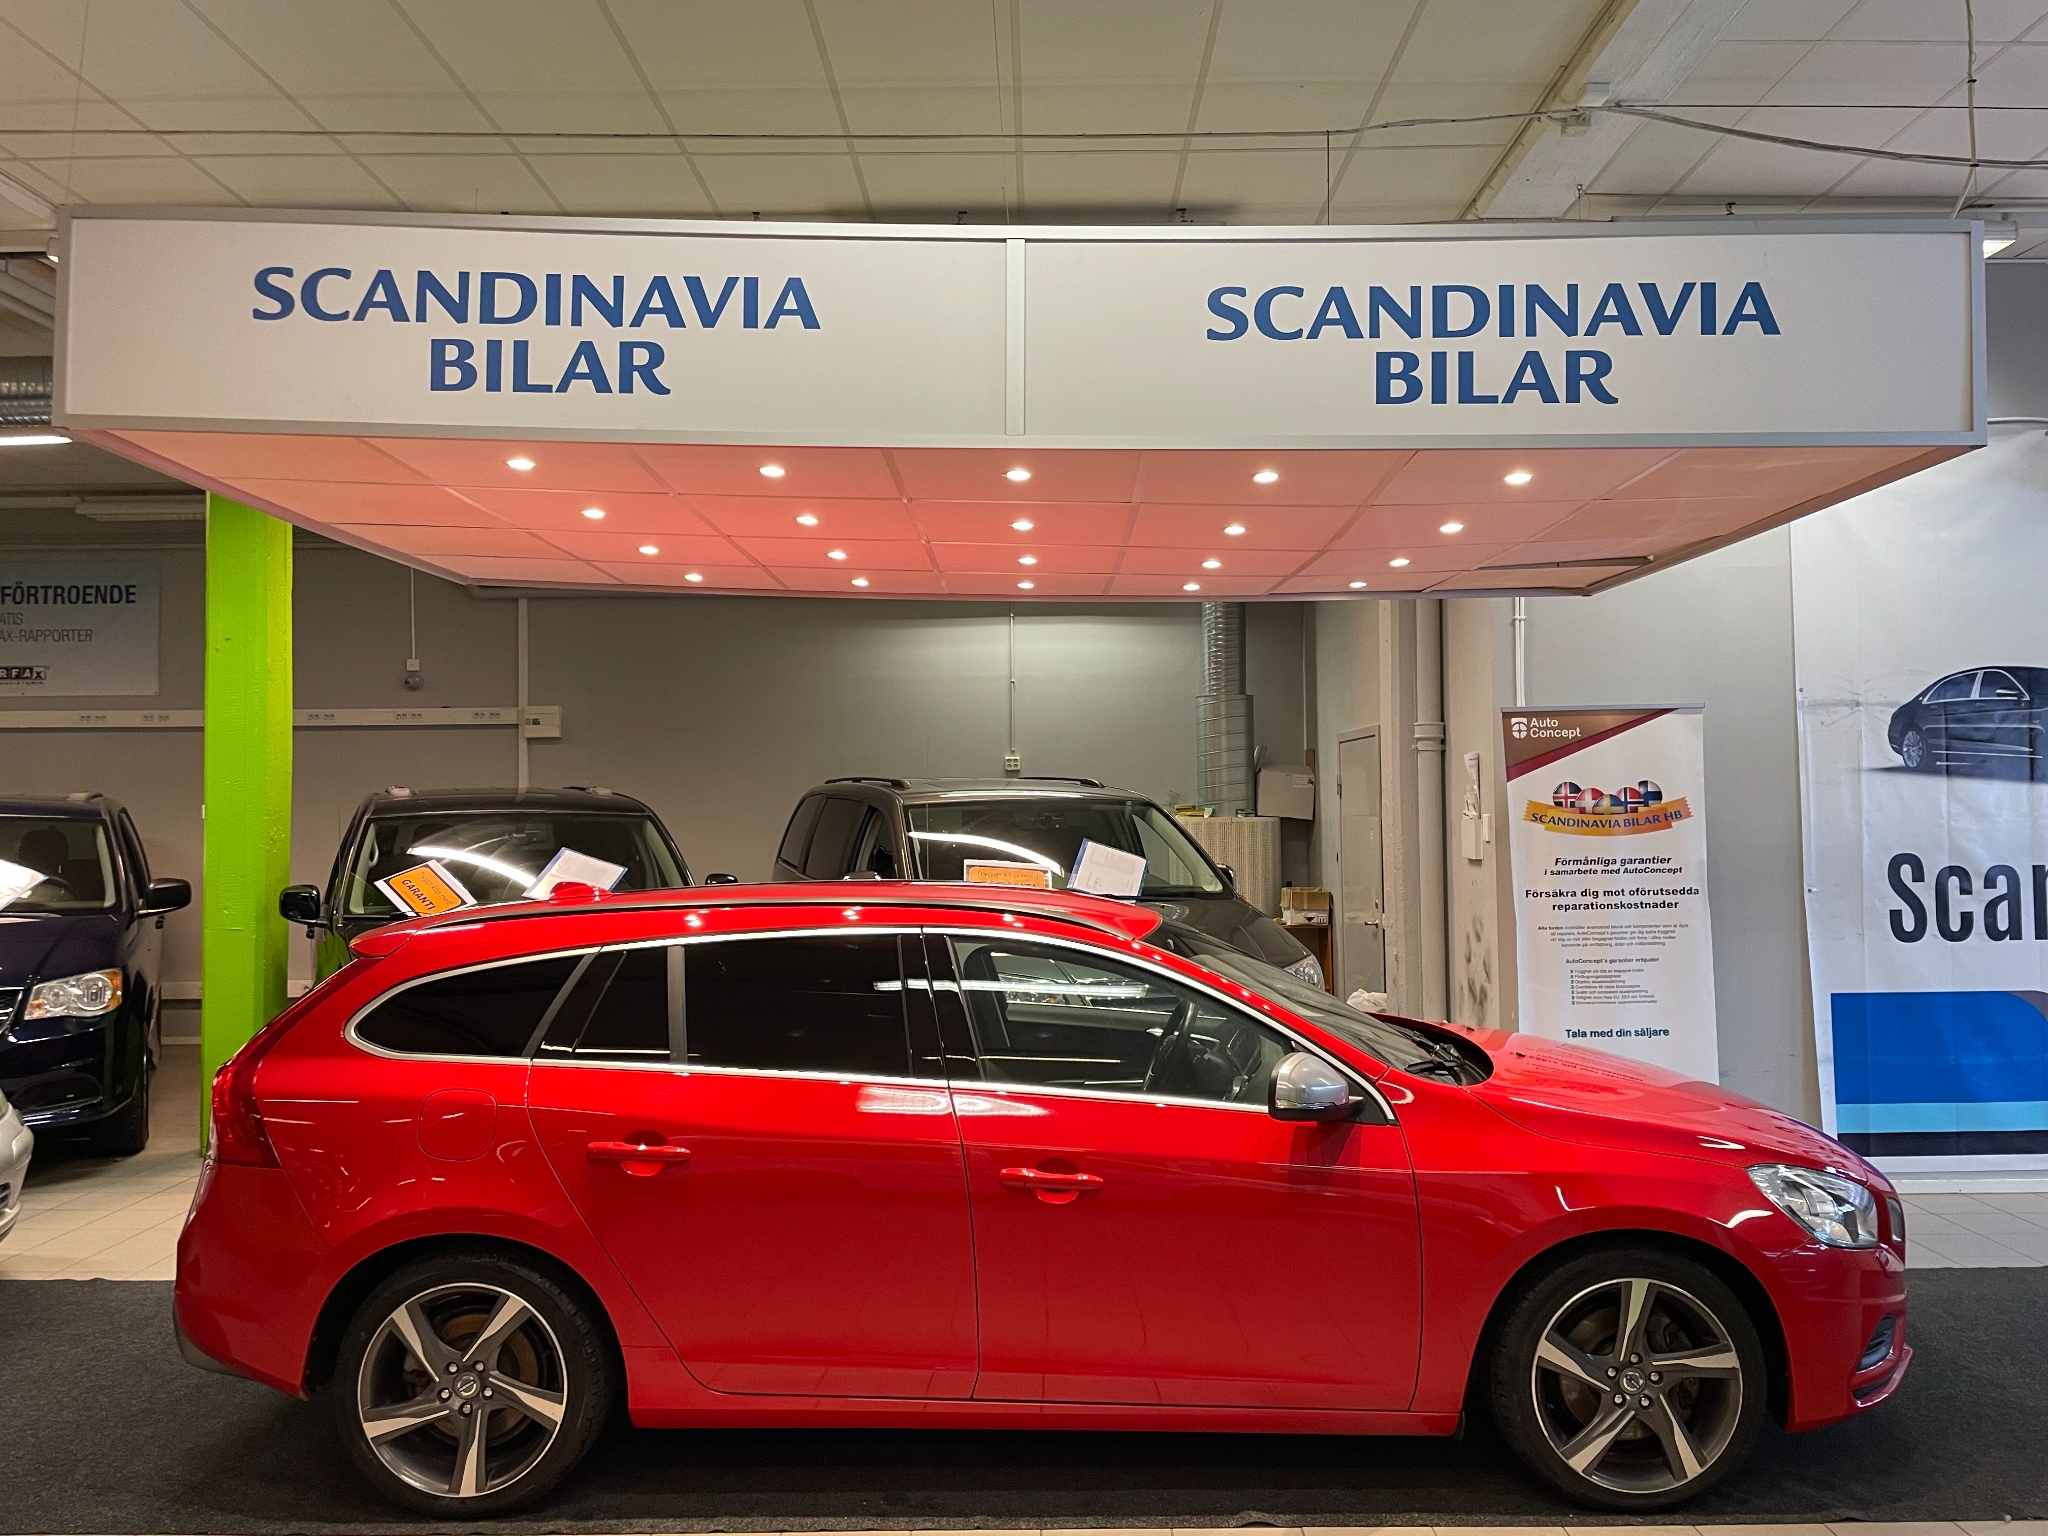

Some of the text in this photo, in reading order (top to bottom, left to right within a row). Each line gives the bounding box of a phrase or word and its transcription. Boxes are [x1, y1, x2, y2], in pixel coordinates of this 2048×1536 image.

[252, 266, 821, 330] SCANDINAVIA
[1206, 282, 1781, 341] SCANDINAVIA
[430, 338, 671, 395] BILAR
[1375, 349, 1619, 405] BILAR
[1, 582, 136, 605] FÖRTROENDE
[1530, 717, 1558, 727] Auto
[1530, 727, 1581, 739] Concept
[1531, 810, 1682, 828] SCANDINAVIA BILAR HB
[1555, 857, 1672, 867] Förmånliga garantier
[1623, 867, 1682, 875] AutoConcept
[402, 879, 436, 910] GARANTI
[1526, 887, 1699, 898] Försäkra dig mot oförutsedda
[1552, 900, 1679, 912] reparationskostnader
[1565, 1028, 1669, 1038] Tala med din säljare
